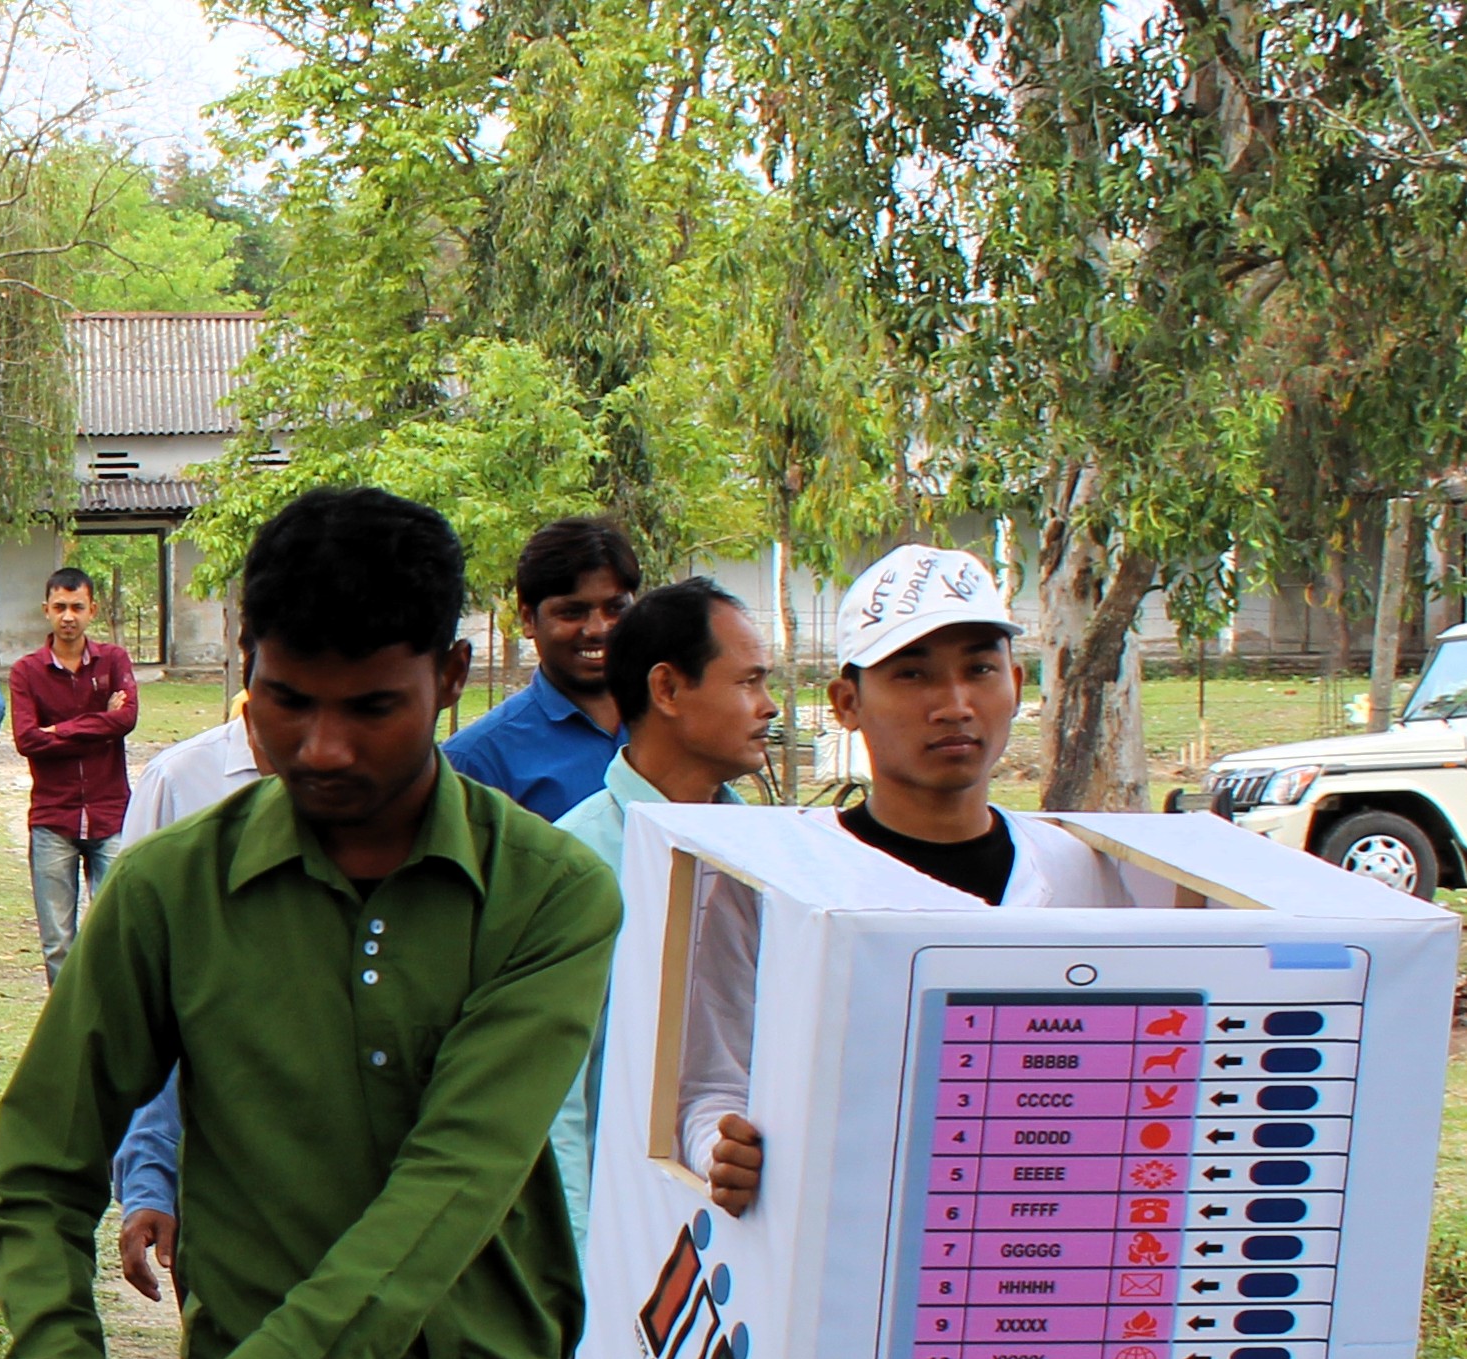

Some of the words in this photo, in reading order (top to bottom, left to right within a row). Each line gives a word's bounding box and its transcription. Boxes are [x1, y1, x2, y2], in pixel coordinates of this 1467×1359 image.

[965, 1016, 976, 1028] 1
[1027, 1019, 1083, 1032] AAAAA
[960, 1054, 973, 1067] 2
[1022, 1055, 1079, 1069] BBBBB
[958, 1094, 971, 1107] 3
[1017, 1093, 1073, 1107] CCCCC
[953, 1131, 966, 1143] 4
[1015, 1131, 1071, 1144] DDDDD
[950, 1168, 963, 1181] 5
[1013, 1167, 1065, 1181] EEEEE
[945, 1207, 960, 1220] 6
[1010, 1203, 1059, 1216] FFFFF
[943, 1244, 956, 1256] 7
[1001, 1244, 1061, 1257] GGGGG
[939, 1281, 953, 1294] 8
[998, 1281, 1055, 1293] HHHHH
[936, 1319, 951, 1331] 9
[996, 1319, 1048, 1332] XXXXX
